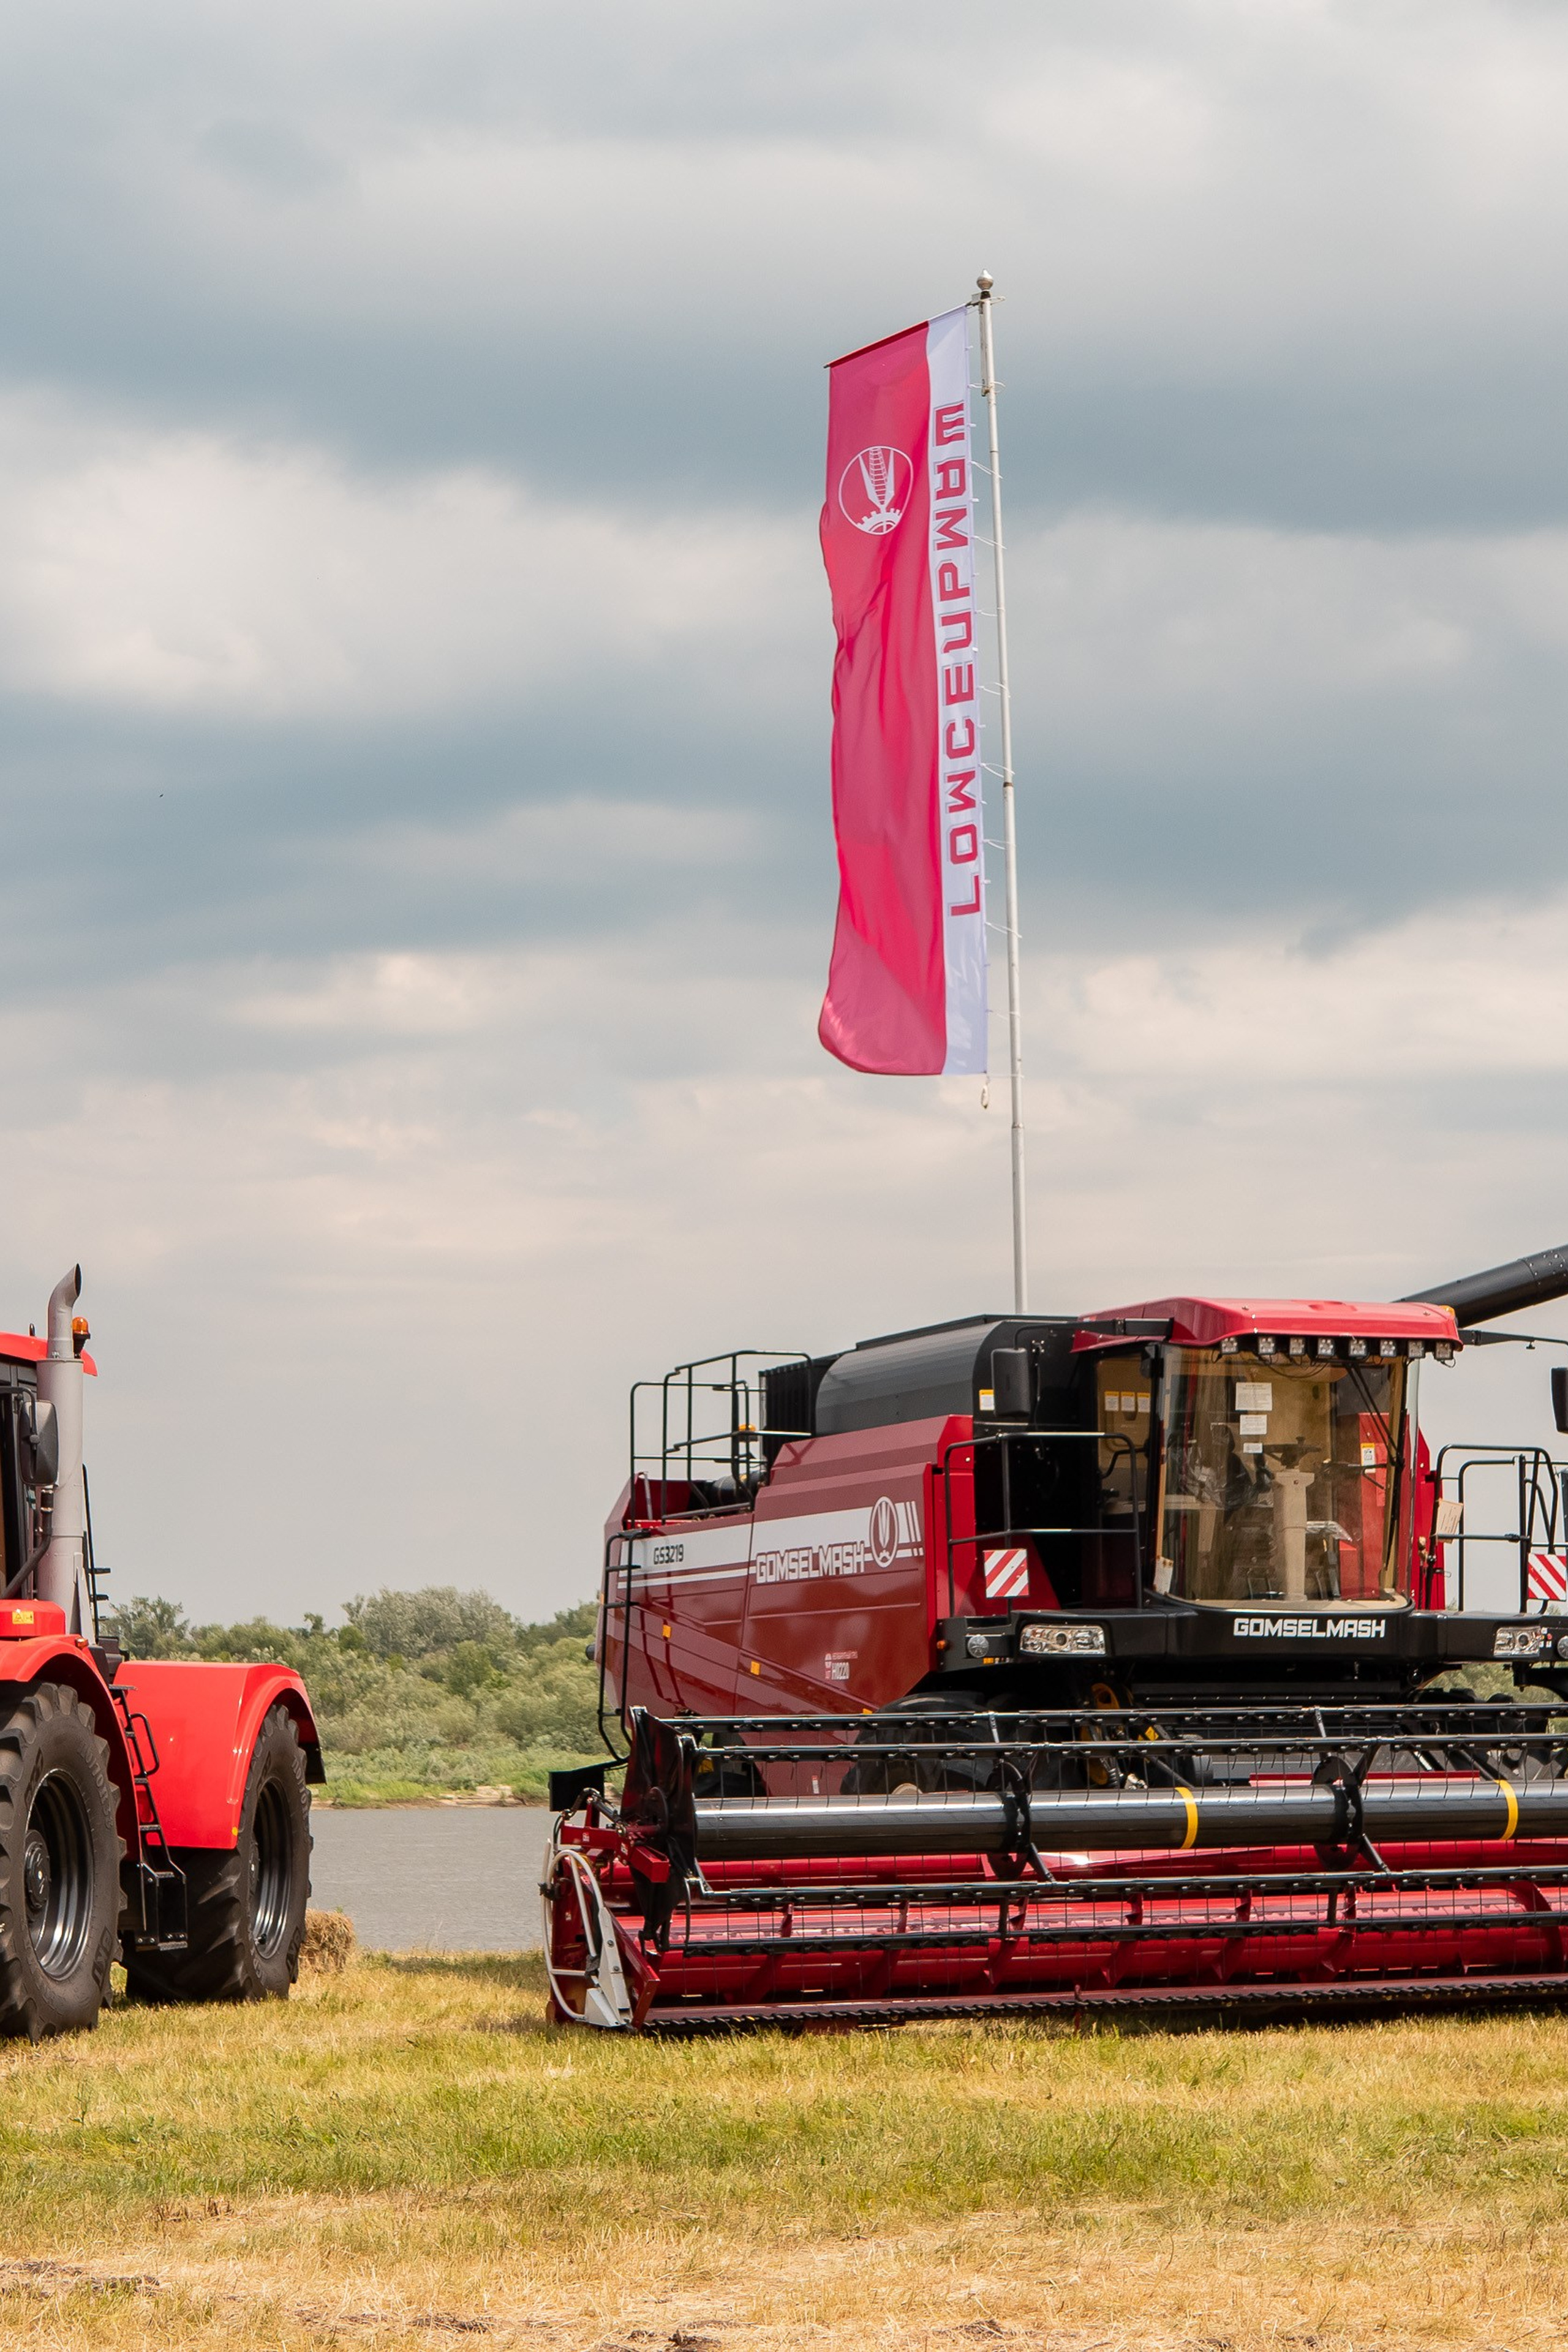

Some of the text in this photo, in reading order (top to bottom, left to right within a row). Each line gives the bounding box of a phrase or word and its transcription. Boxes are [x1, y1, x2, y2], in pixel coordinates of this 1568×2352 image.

[654, 1544, 684, 1565] GS3219
[756, 1541, 864, 1584] GOMSELMASH
[1233, 1618, 1385, 1638] GOMSELMASH
